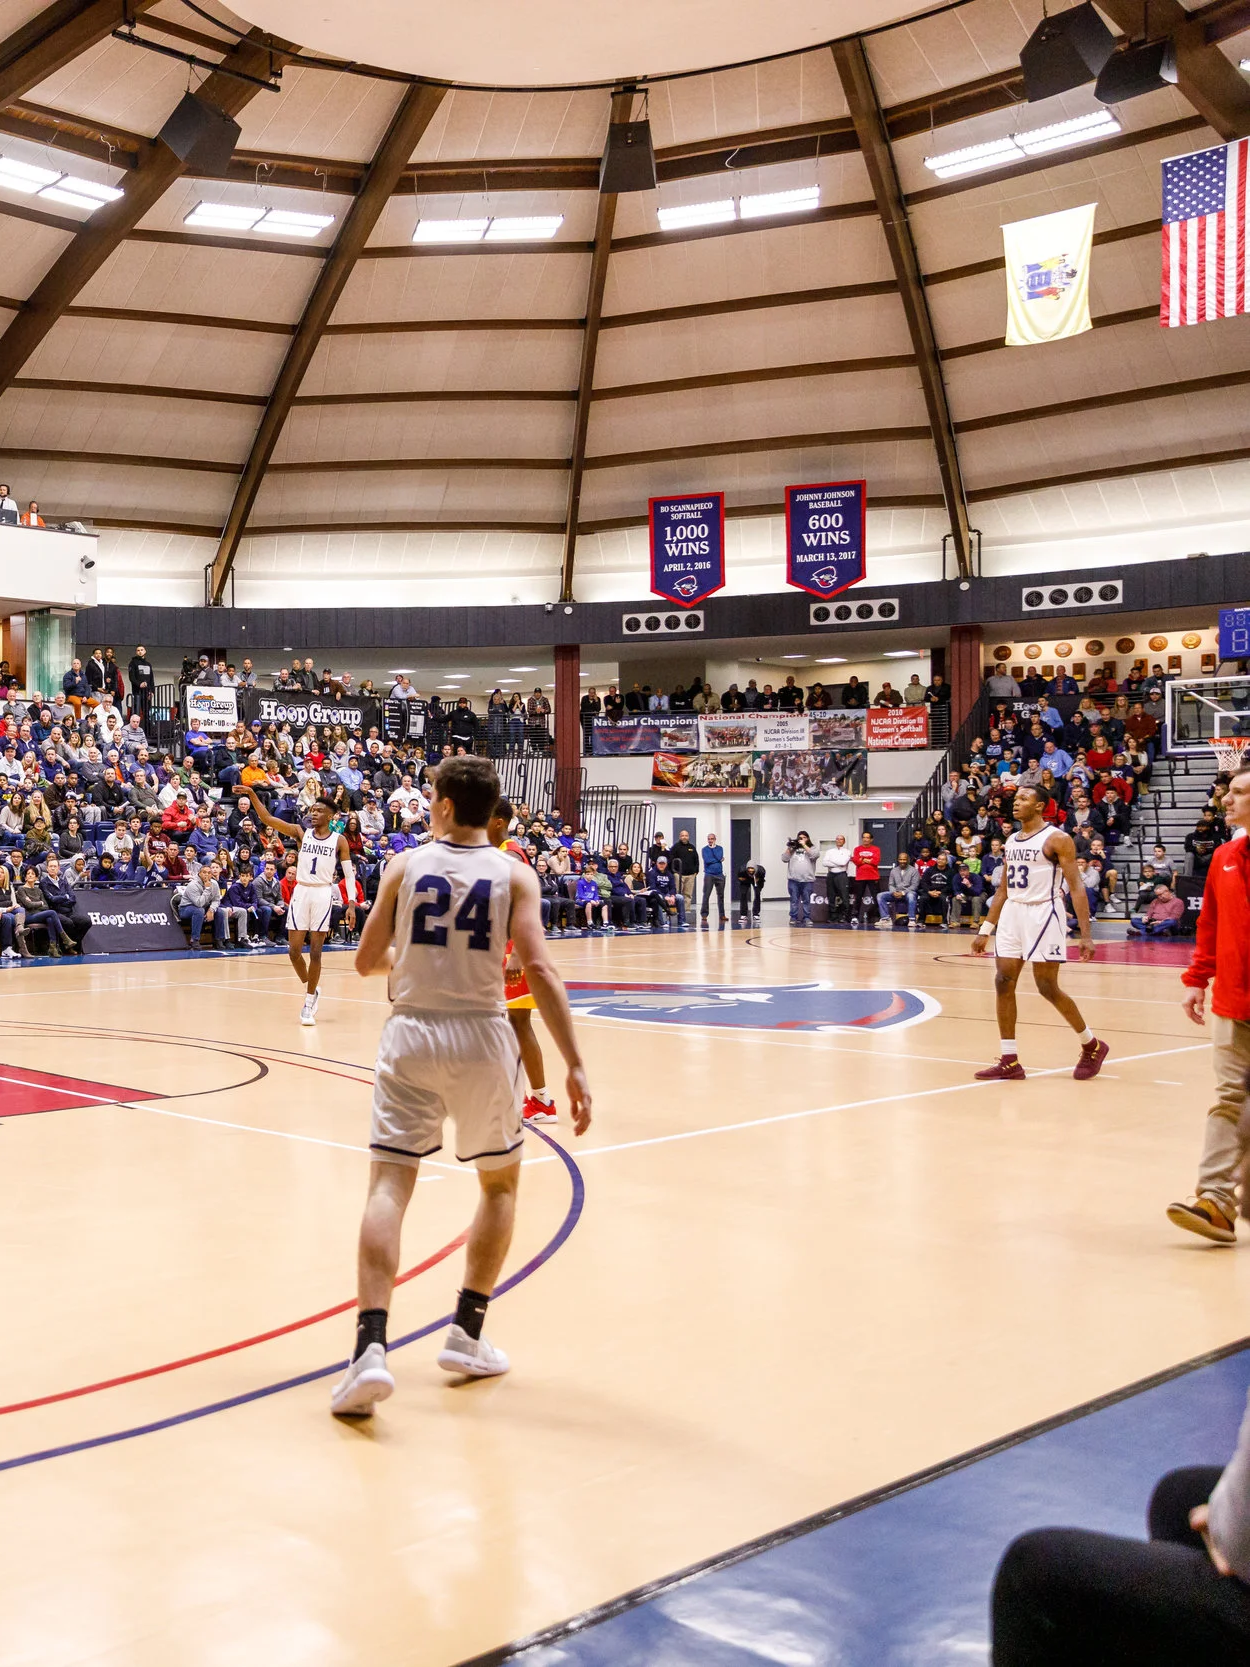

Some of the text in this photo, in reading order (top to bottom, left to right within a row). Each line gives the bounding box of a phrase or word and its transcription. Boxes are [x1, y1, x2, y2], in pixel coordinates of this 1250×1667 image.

[795, 490, 855, 502] JOHNNY JOHNSON
[660, 502, 713, 513] BO SCANNAPIECO
[808, 500, 843, 509] BASEBALL
[670, 511, 702, 520] SOFTBALL
[808, 513, 843, 530] 600
[664, 524, 709, 543] 1,000
[802, 530, 850, 547] WINS
[664, 541, 710, 557] WINS
[796, 551, 856, 563] MARCH 13, 2017
[663, 560, 711, 572] APRIL 2, 2016
[699, 712, 810, 721] National Champions
[888, 709, 904, 717] 2010
[593, 716, 698, 728] Natonal Champions
[892, 717, 917, 725] Division
[872, 725, 923, 734] Women's Softball
[868, 735, 928, 748] National Champions
[302, 841, 335, 857] RANNEY
[309, 857, 318, 875] 1
[1007, 864, 1029, 888] 23
[412, 874, 492, 950] 24
